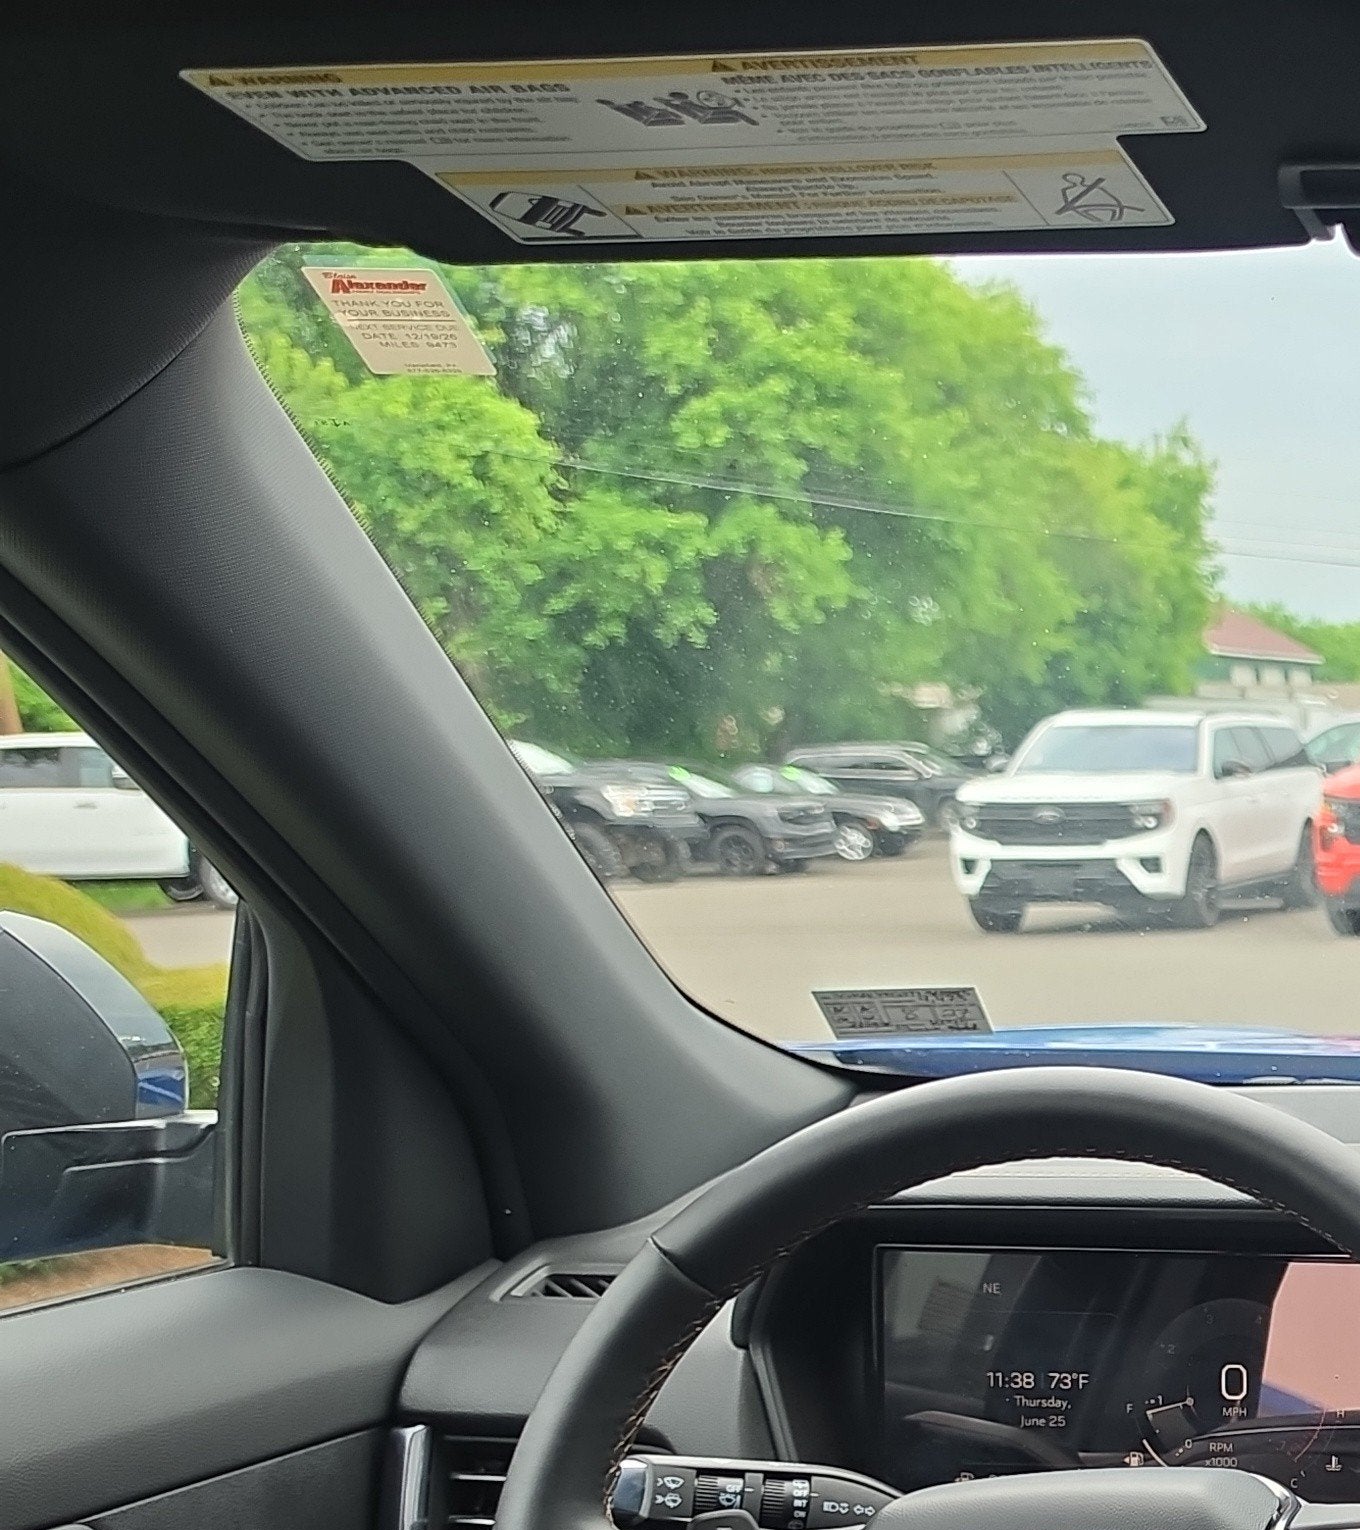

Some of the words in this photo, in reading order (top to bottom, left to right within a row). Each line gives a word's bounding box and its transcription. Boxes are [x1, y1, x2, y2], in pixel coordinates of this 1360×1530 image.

[350, 85, 463, 98] ADVANCED
[468, 84, 508, 95] AIR
[511, 82, 571, 95] BAGS
[330, 278, 427, 295] Alexander
[332, 299, 380, 308] THANK
[380, 299, 413, 308] YOU
[416, 299, 444, 308] FOR
[338, 309, 380, 318] YOUR
[383, 309, 451, 318] BUSINESS
[983, 1283, 1001, 1295] NE
[987, 1372, 1035, 1388] 11:38
[1049, 1372, 1090, 1388] 73°F
[1221, 1364, 1247, 1401] 0
[1014, 1396, 1072, 1410] Thursday,
[1127, 1403, 1134, 1414] F
[1222, 1407, 1247, 1418] MPH
[1020, 1415, 1044, 1429] June
[1049, 1415, 1066, 1427] 25
[1210, 1443, 1233, 1453] RPM
[1205, 1457, 1238, 1468] x1000
[1291, 1478, 1298, 1489] C
